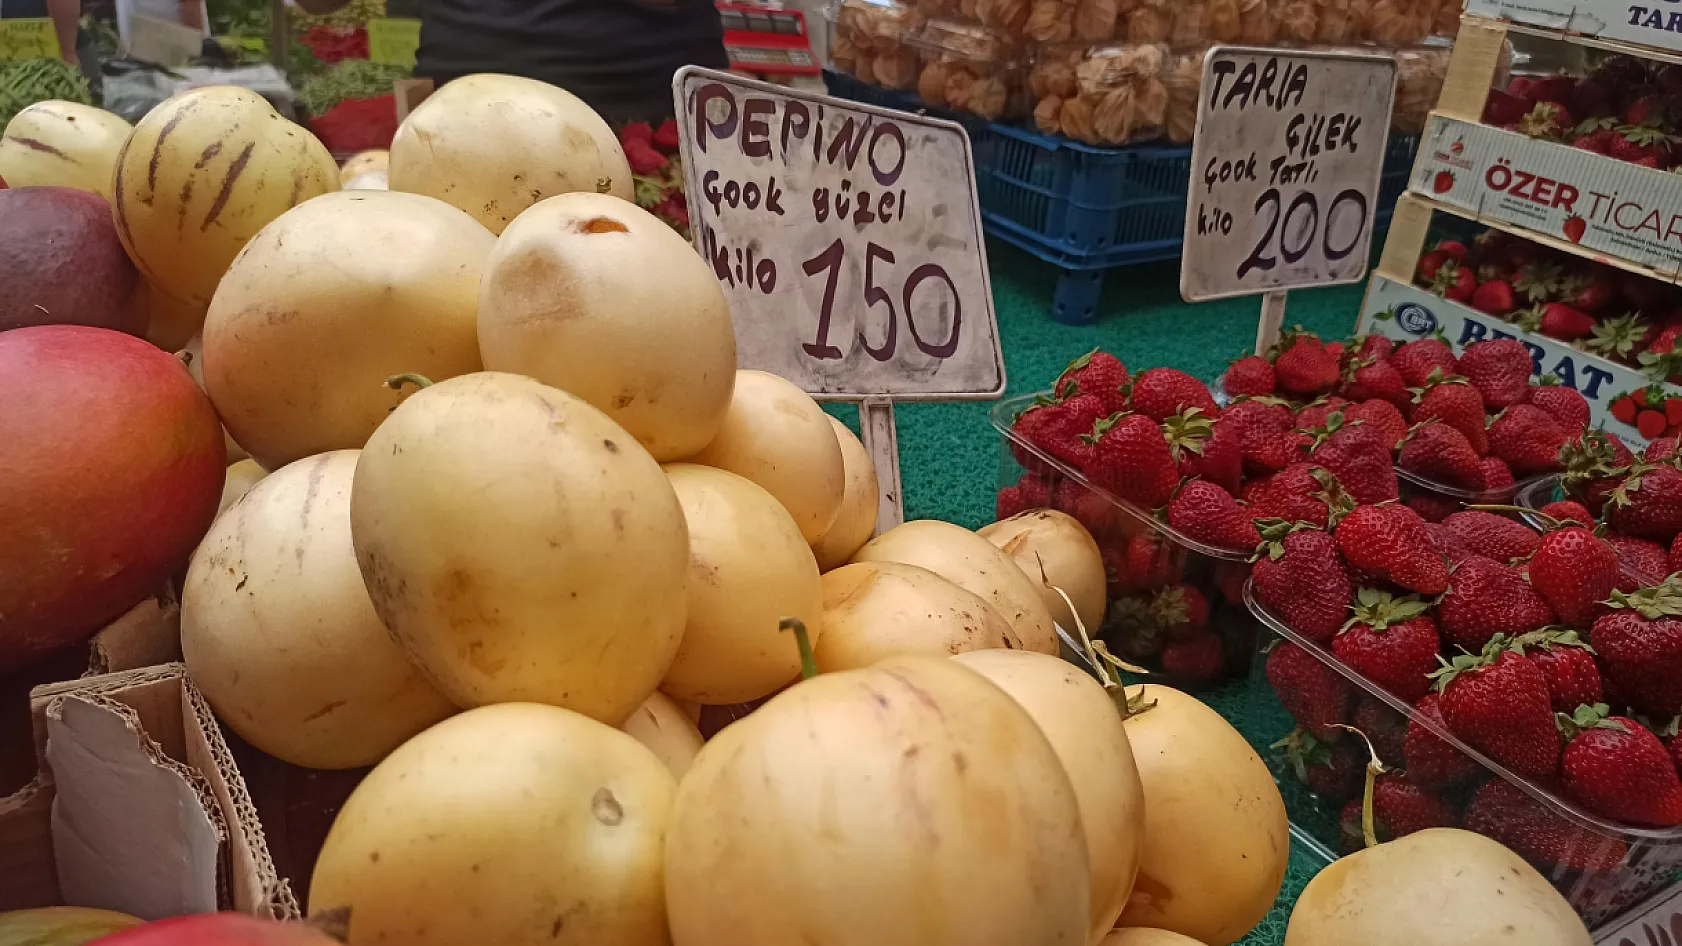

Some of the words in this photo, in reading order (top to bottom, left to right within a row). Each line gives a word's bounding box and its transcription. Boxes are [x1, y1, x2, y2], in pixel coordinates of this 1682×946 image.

[812, 178, 906, 226] güzel
[1485, 156, 1580, 214] ÖZER
[1197, 202, 1232, 237] kilo
[1236, 188, 1367, 281] 200
[707, 223, 777, 294] kilo
[802, 237, 962, 362] 150
[1456, 317, 1614, 400] BRAT
